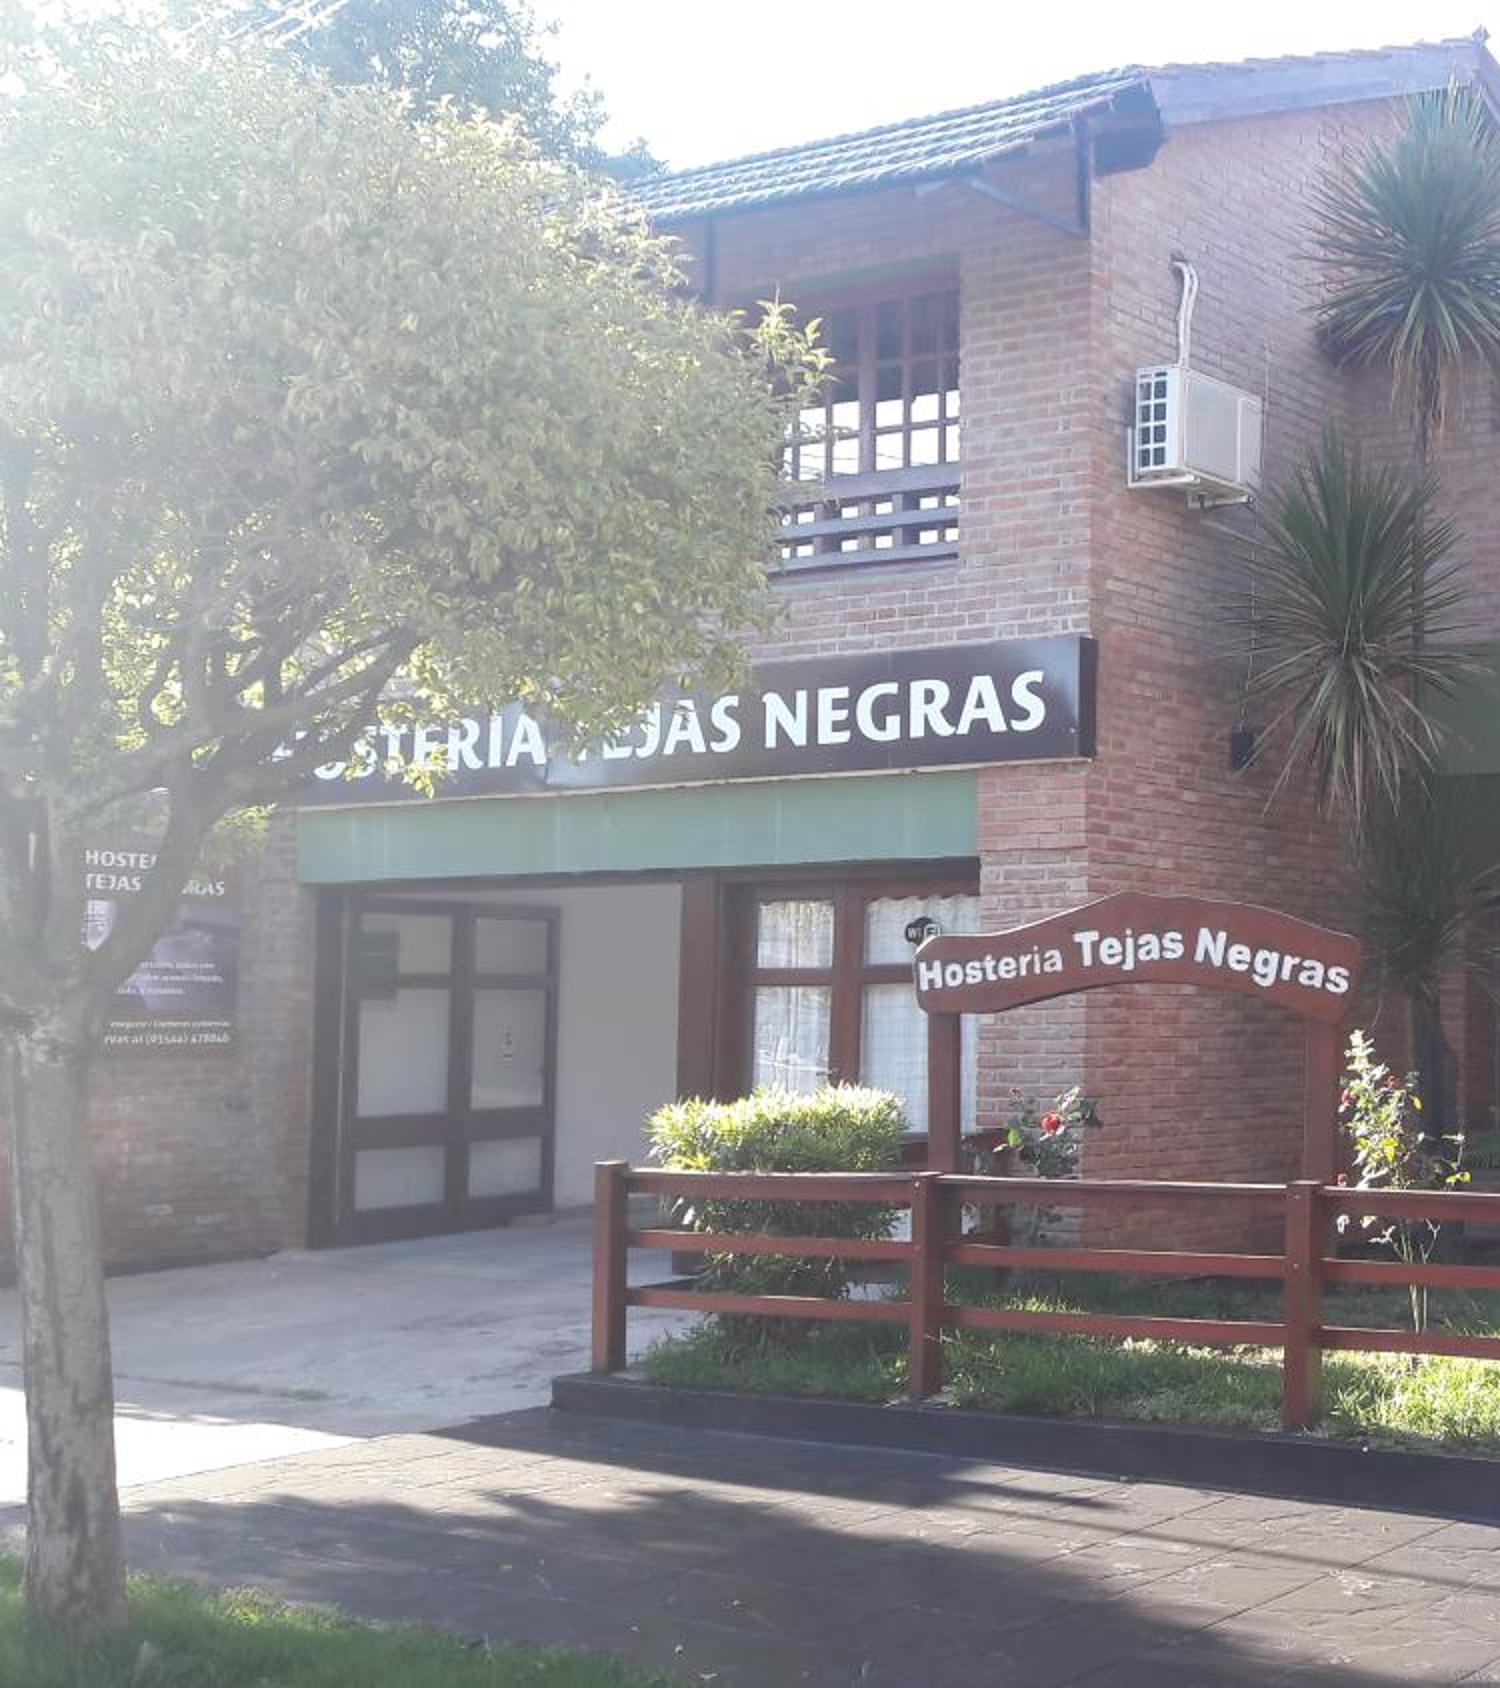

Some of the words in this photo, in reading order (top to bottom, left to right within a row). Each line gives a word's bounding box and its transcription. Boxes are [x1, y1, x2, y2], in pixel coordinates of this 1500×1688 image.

[761, 670, 1047, 749] NEGRAS
[85, 872, 142, 891] TEJAS
[918, 945, 1063, 991] Hosteria
[1073, 928, 1185, 971] Tejas
[1194, 927, 1350, 994] Negras
